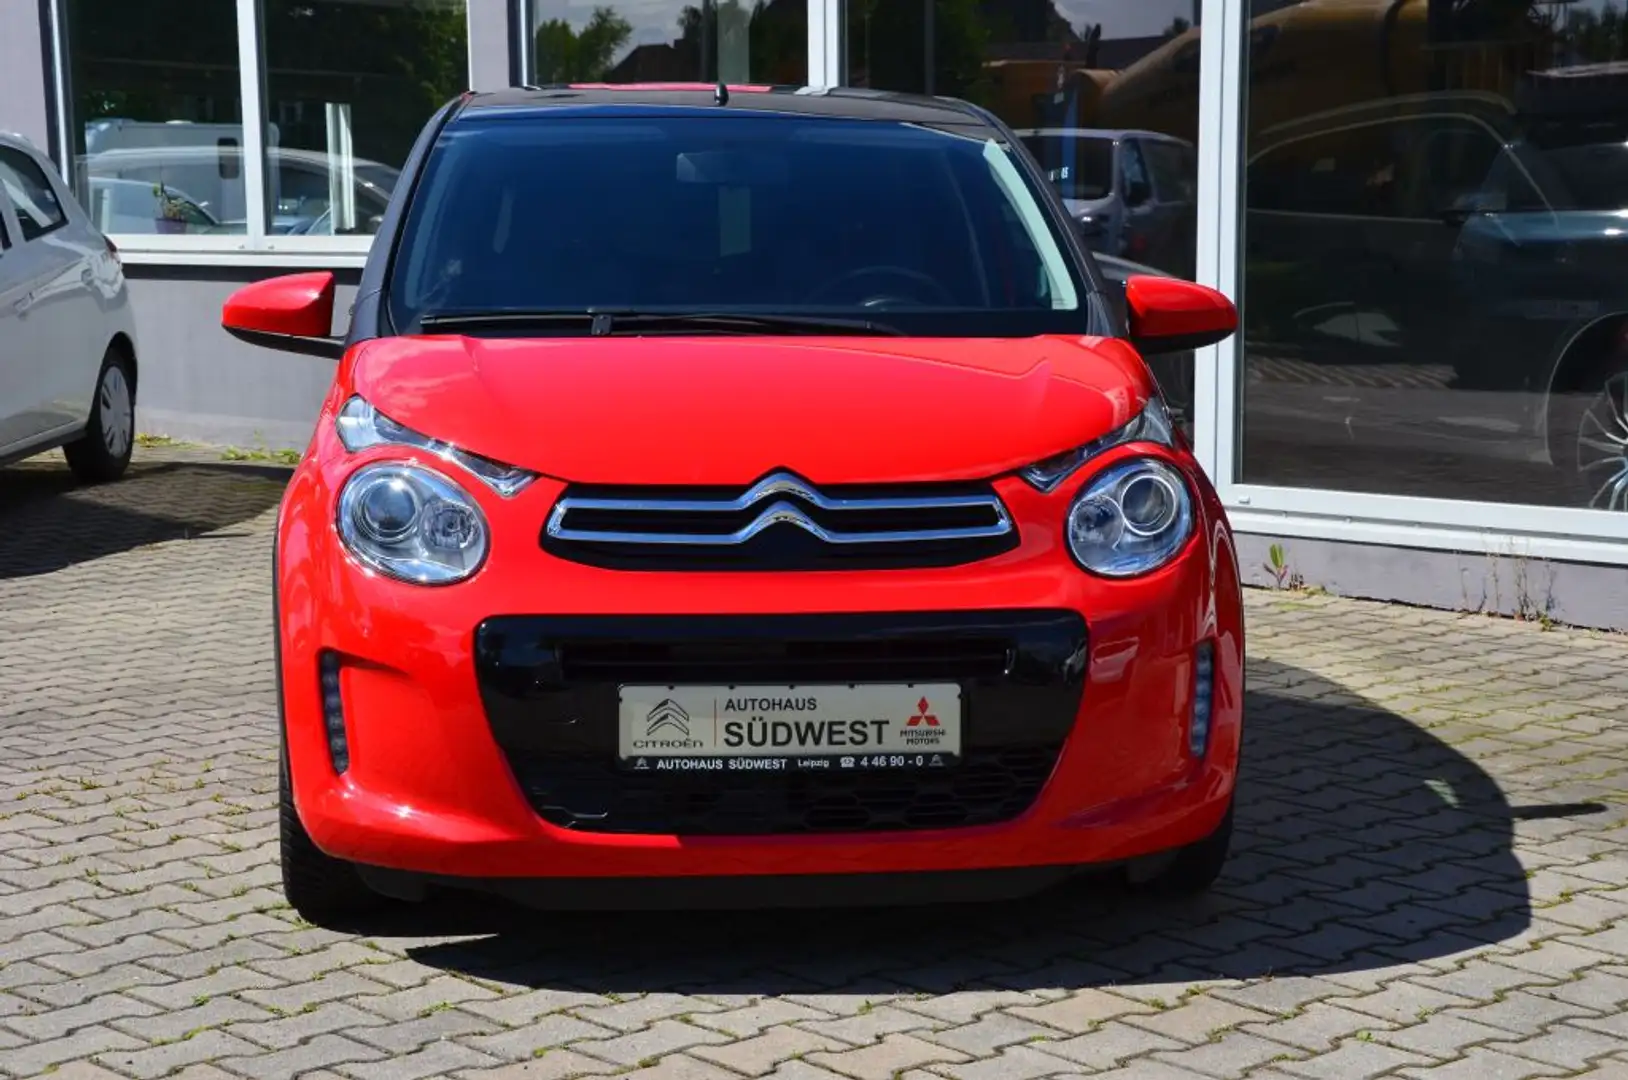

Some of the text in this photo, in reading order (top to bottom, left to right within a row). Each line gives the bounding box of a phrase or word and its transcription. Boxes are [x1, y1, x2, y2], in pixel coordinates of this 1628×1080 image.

[725, 698, 817, 711] AUTOHAUS
[723, 716, 890, 747] SÜDWEST
[633, 738, 703, 749] CITROËN
[906, 737, 940, 746] MOTORS
[656, 758, 723, 770] AUTOHAUS
[728, 757, 788, 770] SÜDWEST
[798, 759, 830, 769] Leipzig
[860, 756, 868, 767] 4
[872, 756, 887, 767] 46
[890, 756, 905, 767] 90
[916, 756, 924, 767] 0
